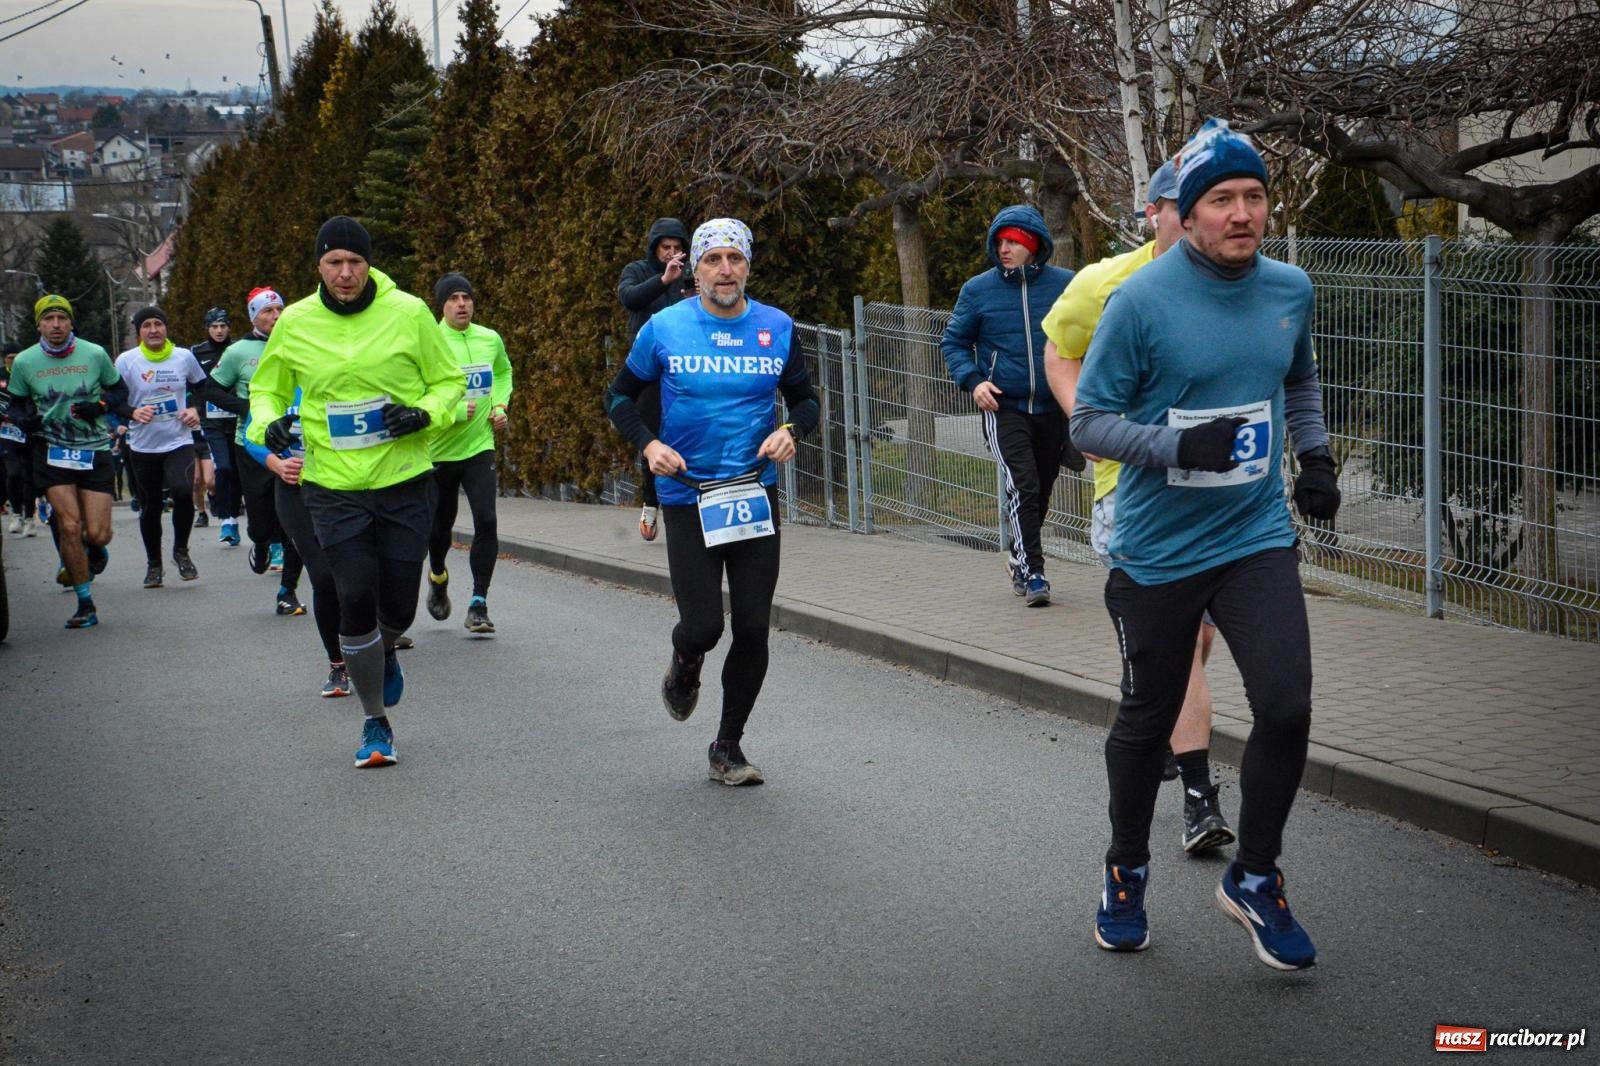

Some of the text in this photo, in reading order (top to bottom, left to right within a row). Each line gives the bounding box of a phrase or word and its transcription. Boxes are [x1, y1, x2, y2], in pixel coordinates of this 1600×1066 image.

[668, 355, 784, 376] RUNNERS
[353, 413, 368, 434] 5
[1231, 427, 1257, 461] 3
[62, 449, 81, 461] 18
[719, 500, 753, 526] 78
